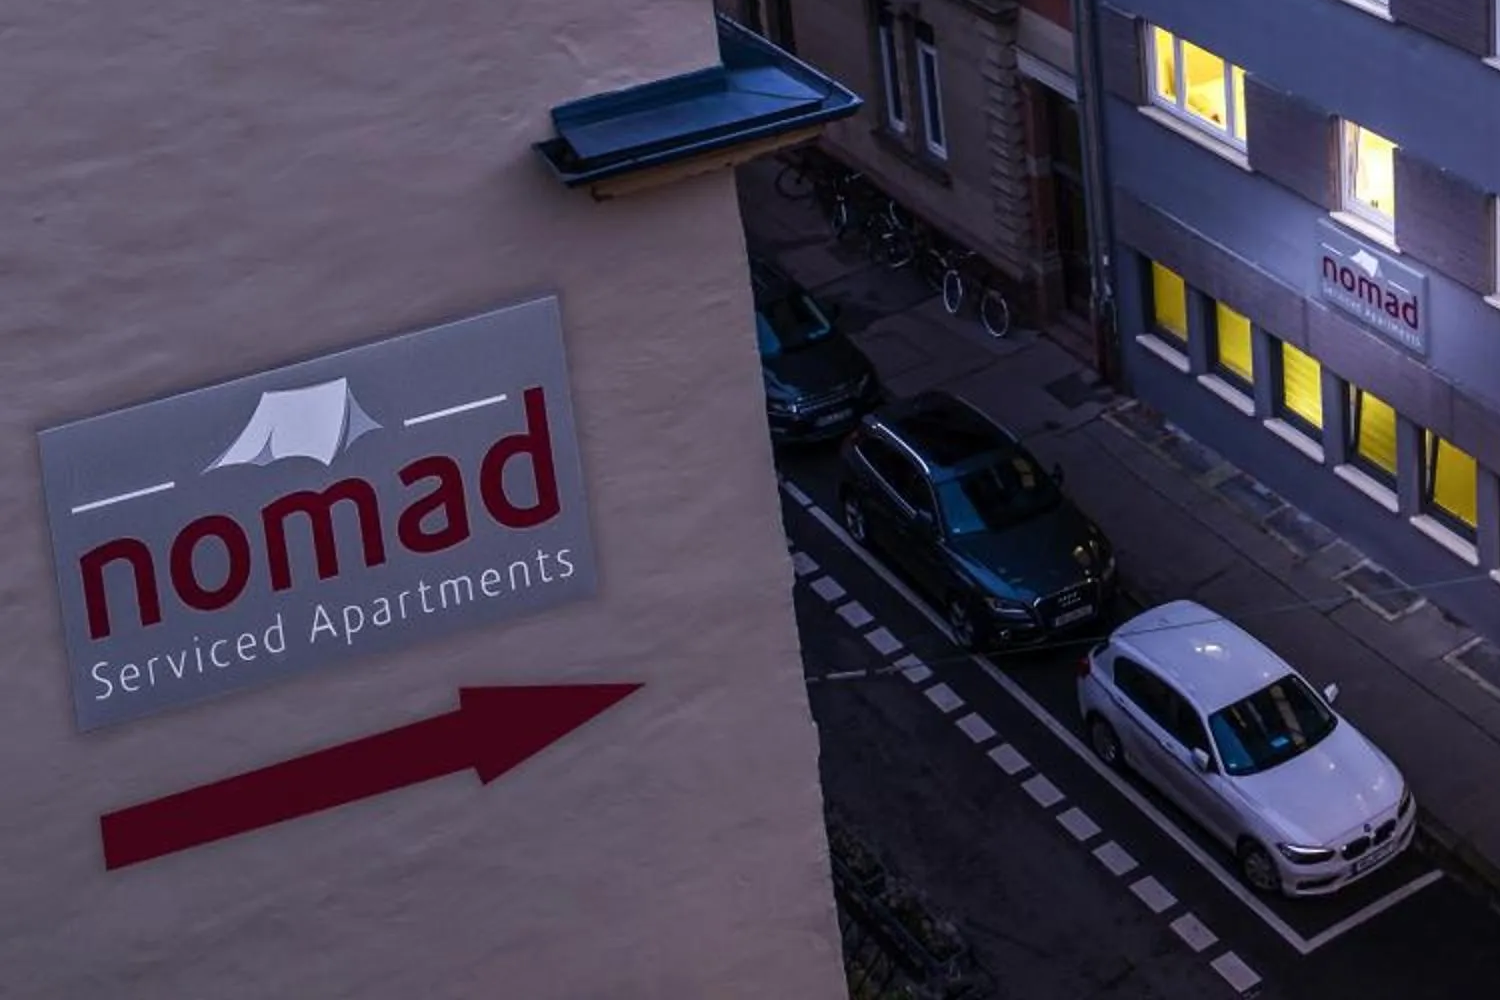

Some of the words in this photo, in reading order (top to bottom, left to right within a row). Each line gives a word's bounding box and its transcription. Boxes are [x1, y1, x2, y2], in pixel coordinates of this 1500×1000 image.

[1322, 255, 1419, 330] nomad
[79, 386, 562, 640] nomad
[91, 614, 287, 700] Serviced
[309, 546, 575, 645] Apartments
